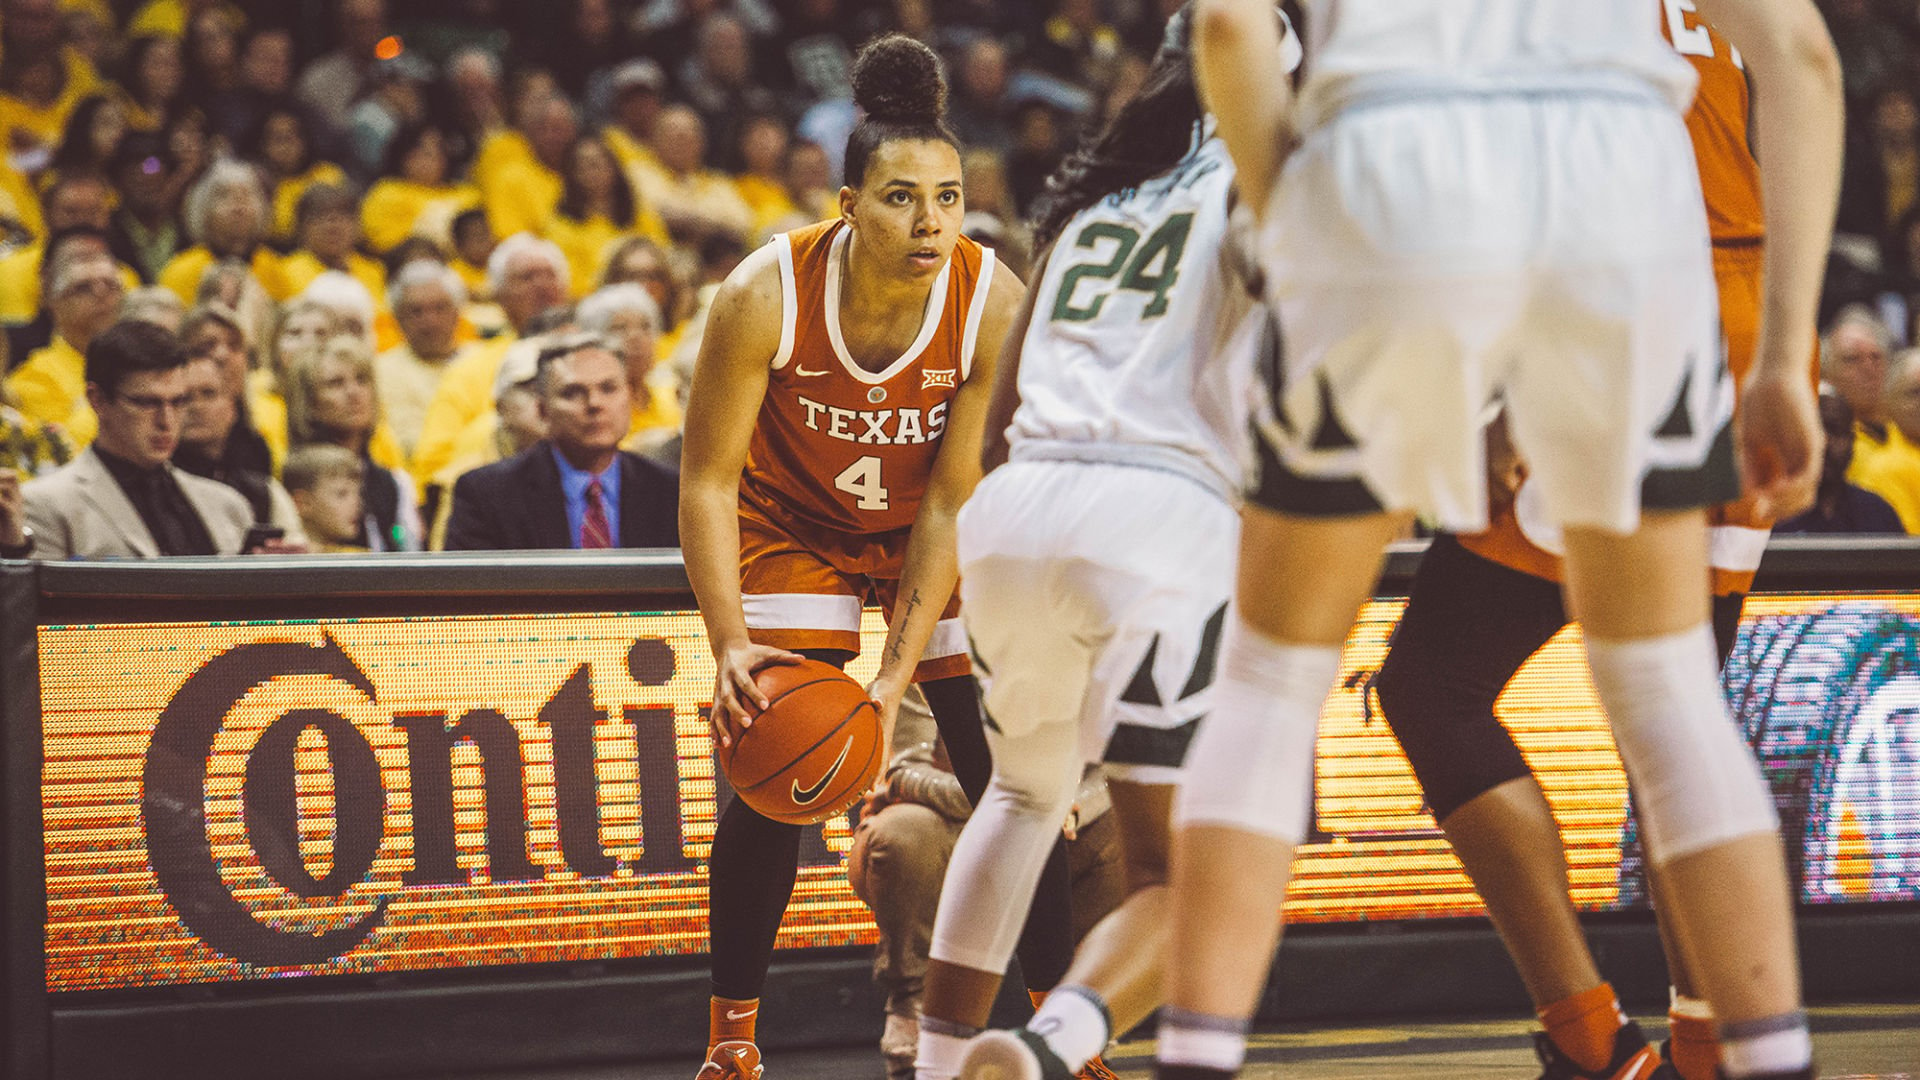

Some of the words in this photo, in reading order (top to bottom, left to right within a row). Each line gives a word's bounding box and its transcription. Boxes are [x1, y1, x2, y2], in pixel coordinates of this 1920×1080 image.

[1050, 211, 1196, 322] 24
[798, 395, 948, 445] TEXAS
[834, 455, 889, 510] 4
[142, 630, 850, 970] Conti
